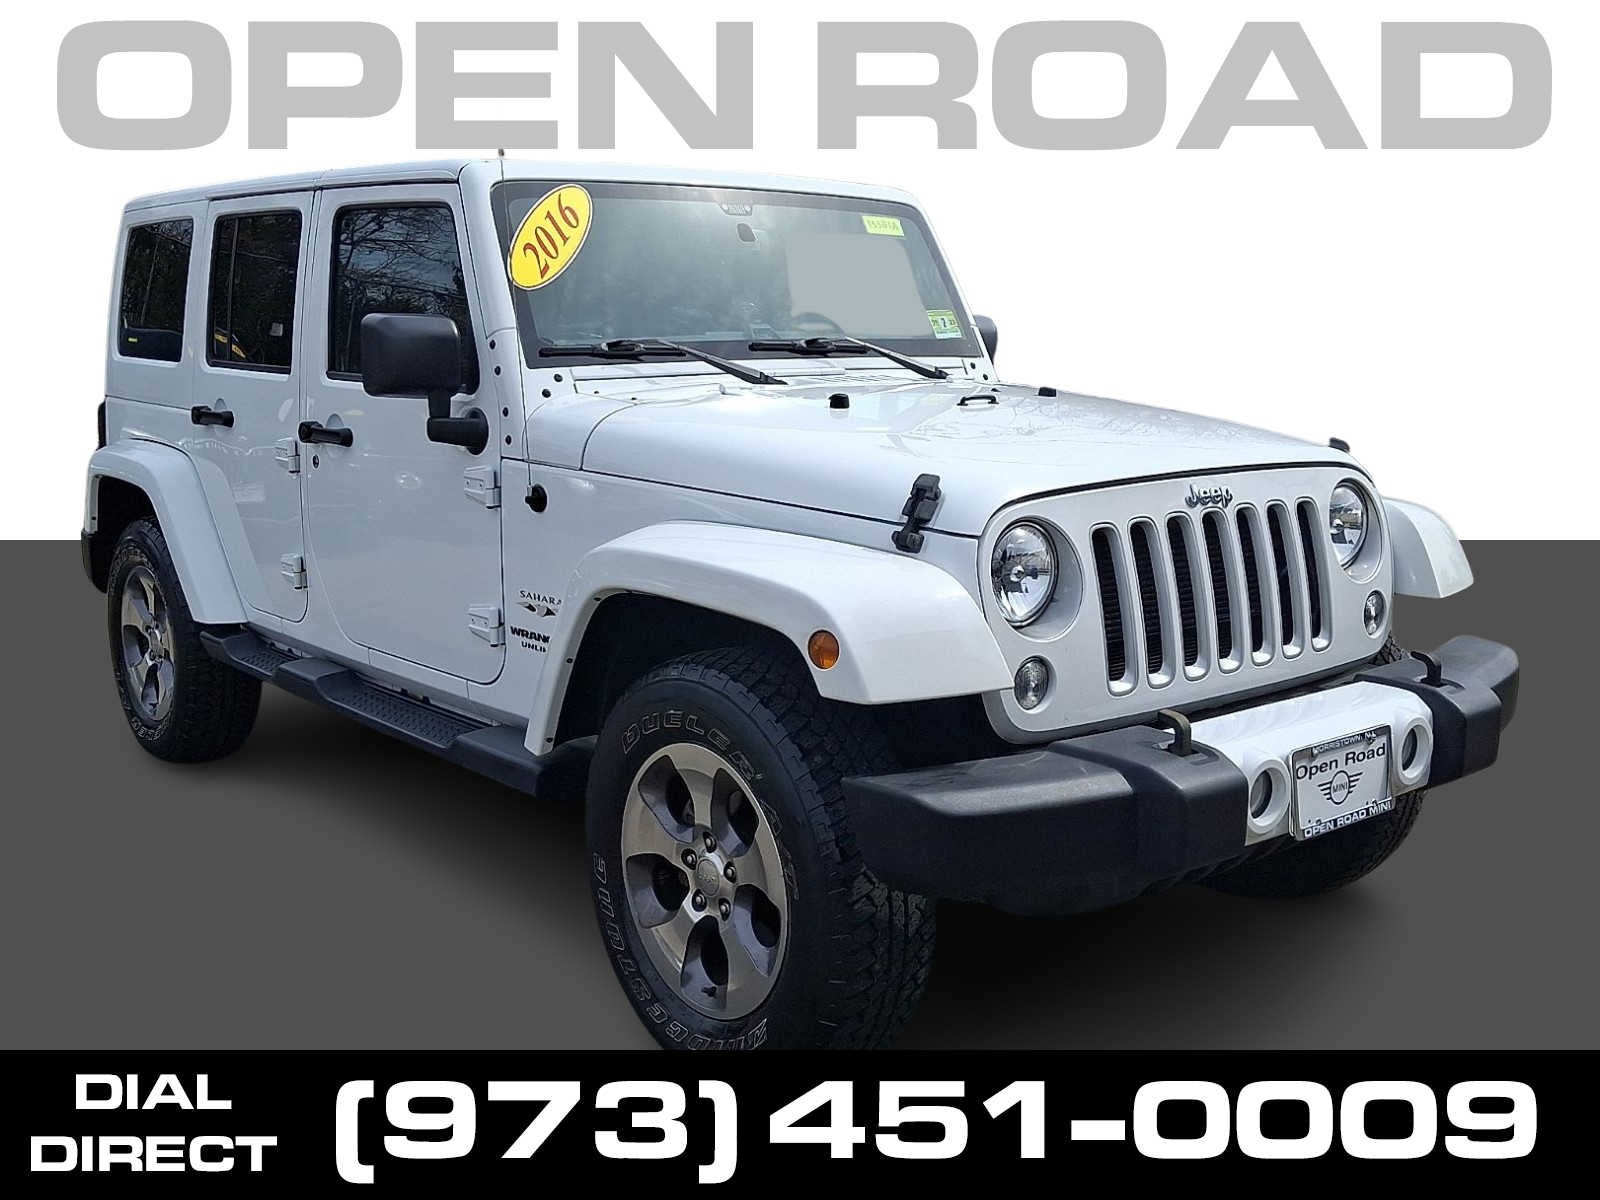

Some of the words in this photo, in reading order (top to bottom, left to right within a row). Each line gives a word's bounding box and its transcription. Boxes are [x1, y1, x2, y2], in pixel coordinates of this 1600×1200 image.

[523, 193, 579, 279] 2016
[1184, 483, 1233, 509] Jeep
[519, 590, 562, 606] SAHARA
[1295, 758, 1338, 780] Open
[1345, 743, 1386, 766] Road
[1332, 780, 1348, 794] MINI
[1304, 821, 1334, 837] OPEN
[1336, 810, 1367, 827] ROAD
[1369, 801, 1391, 815] MINI
